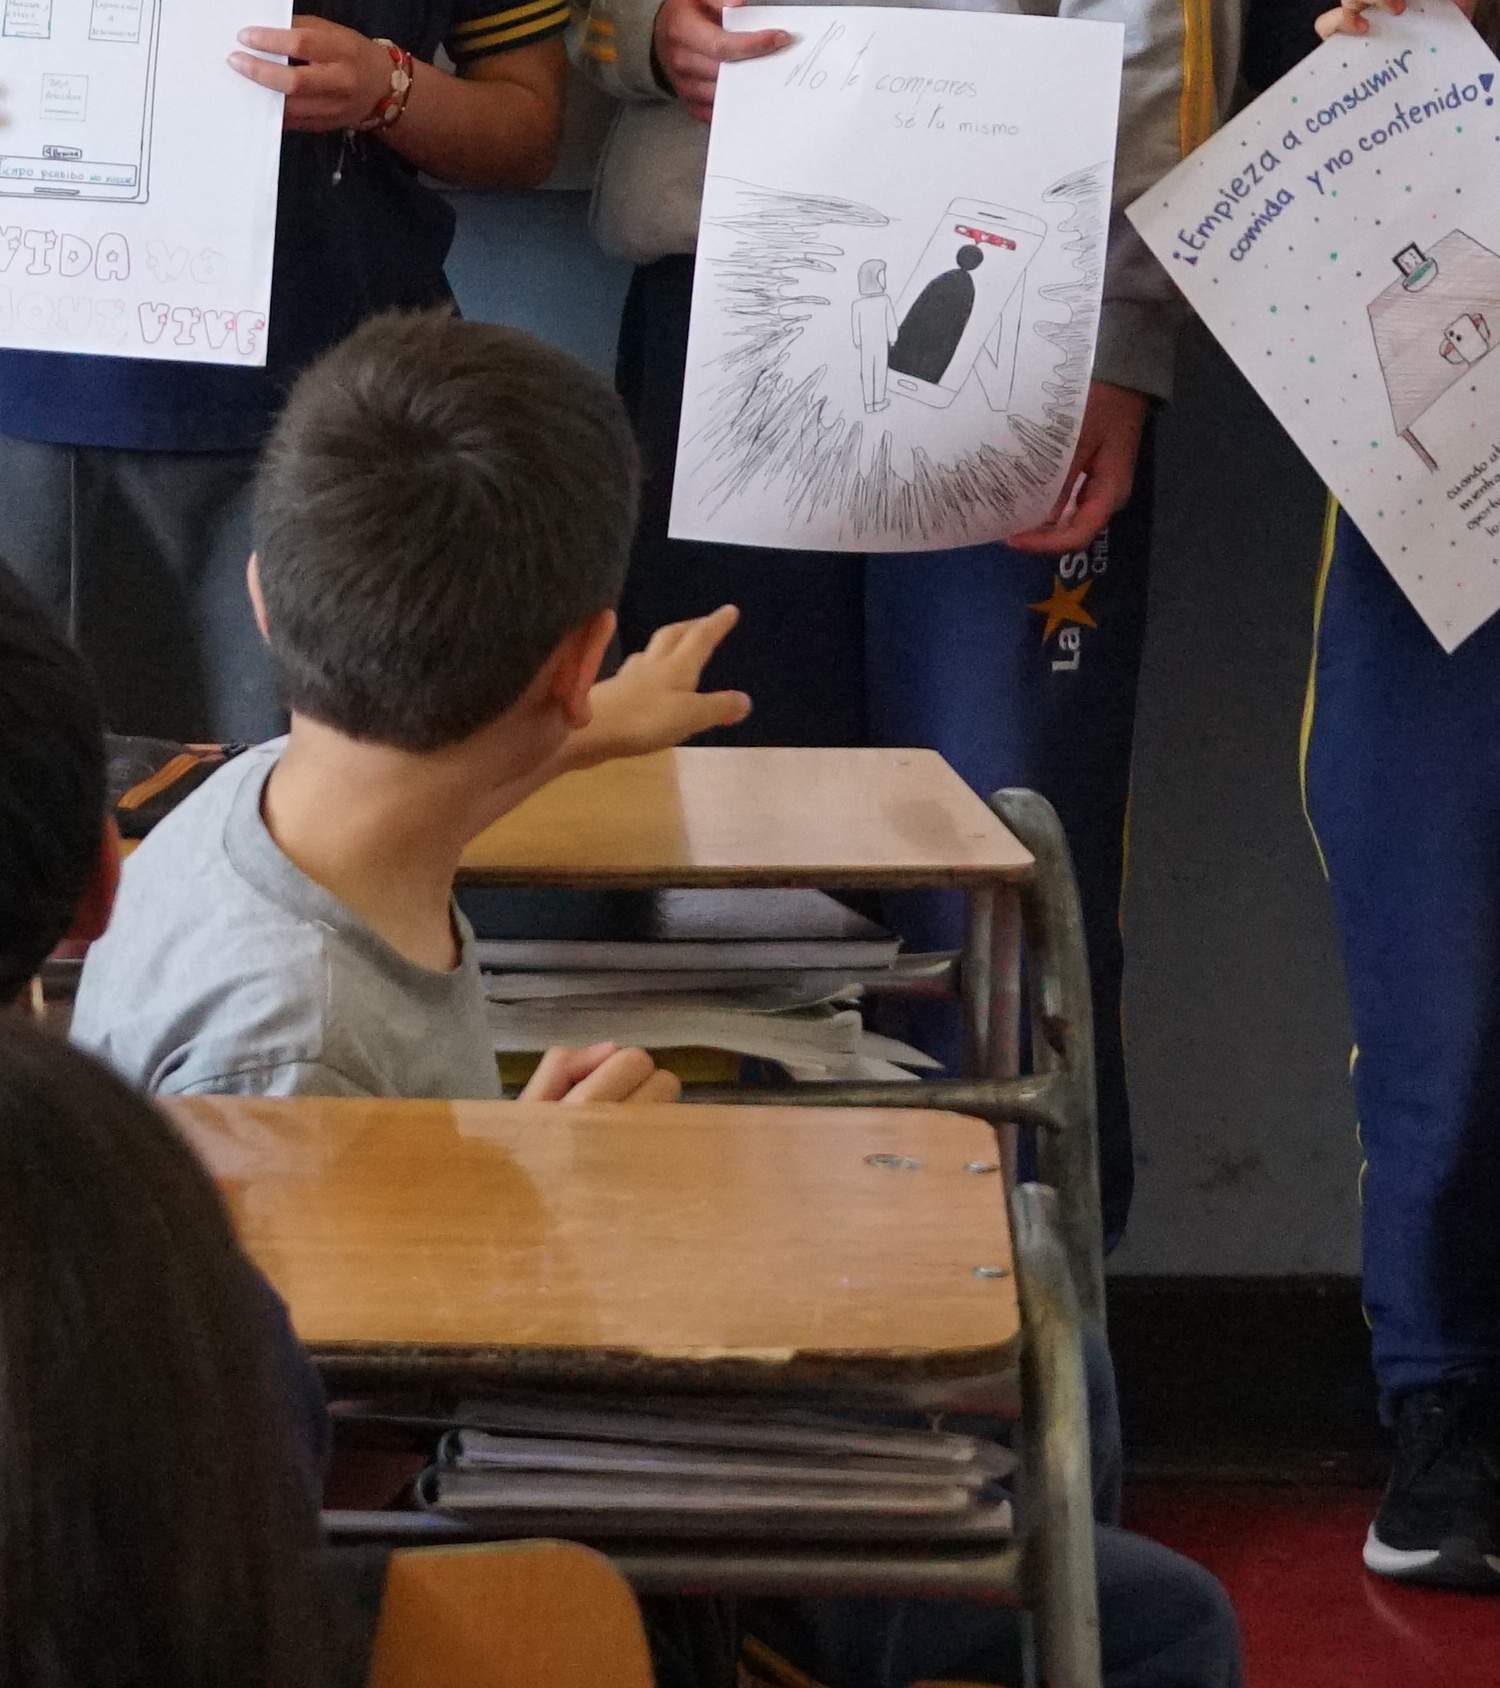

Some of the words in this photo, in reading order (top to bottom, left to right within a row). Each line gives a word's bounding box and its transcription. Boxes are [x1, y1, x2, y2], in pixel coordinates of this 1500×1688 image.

[784, 20, 846, 90] No
[875, 73, 979, 104] compares
[958, 120, 1020, 137] mismo
[1281, 130, 1302, 150] a
[1304, 49, 1413, 134] consumir
[1228, 187, 1296, 262] comida
[1324, 149, 1354, 174] no
[1358, 73, 1495, 152] contenido!
[137, 301, 266, 355] VIVE
[1051, 626, 1081, 672] La
